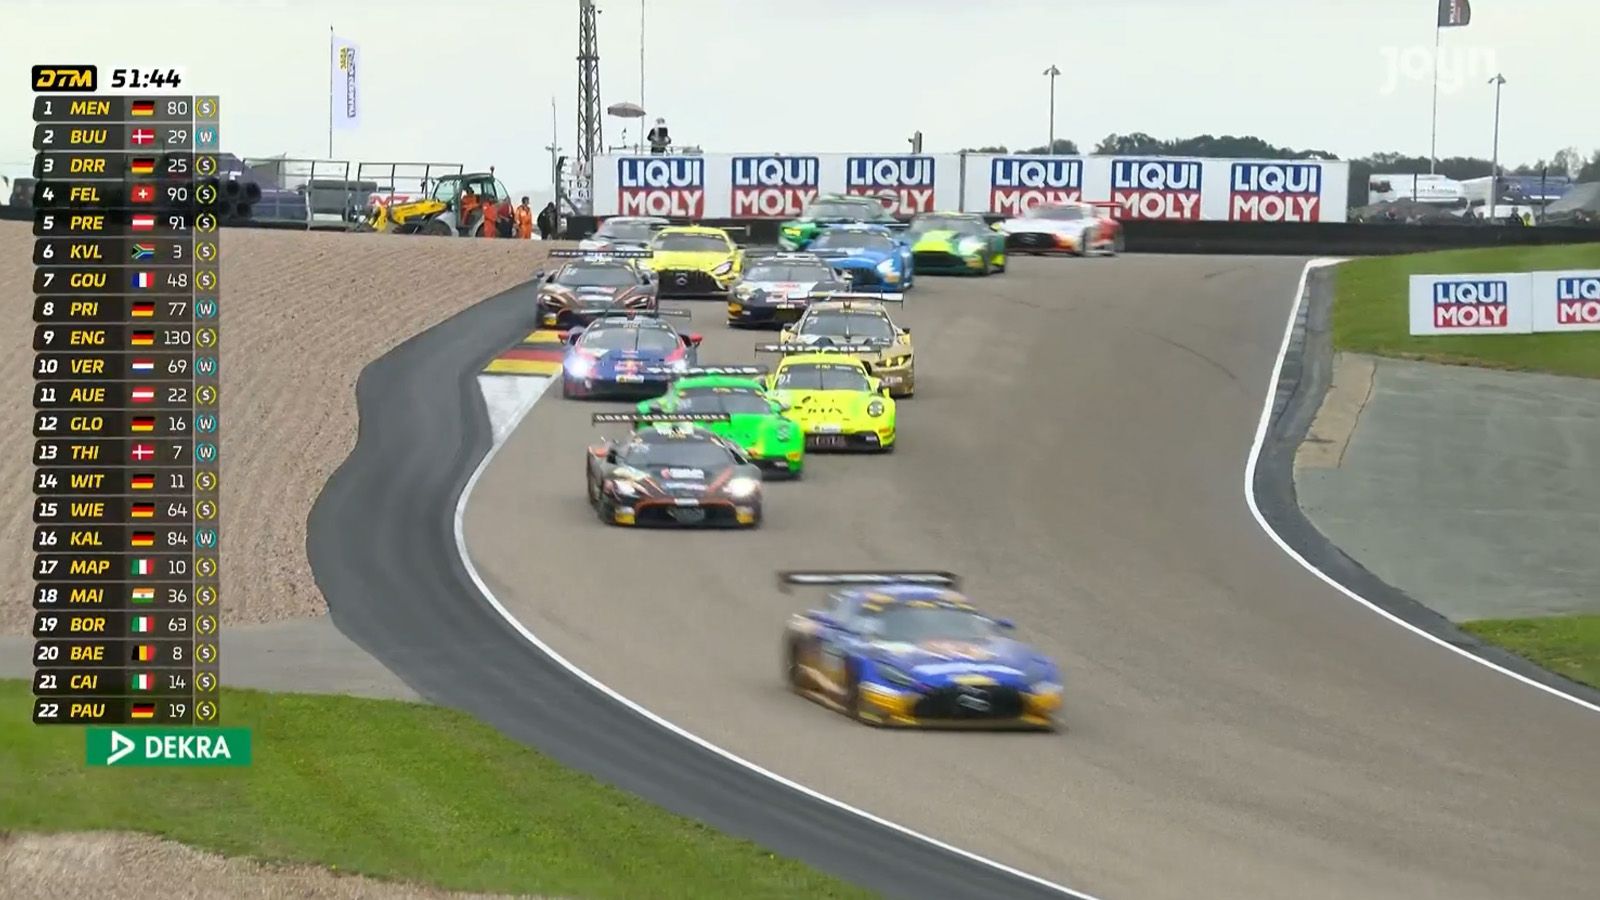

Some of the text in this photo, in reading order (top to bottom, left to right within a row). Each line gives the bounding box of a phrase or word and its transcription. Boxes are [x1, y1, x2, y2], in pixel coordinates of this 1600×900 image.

[622, 160, 700, 188] LIQUI
[736, 159, 815, 186] LIQUI
[851, 159, 931, 186] LIQUI
[996, 161, 1079, 188] LIQUI
[1115, 162, 1198, 190] LIQUI
[1235, 165, 1318, 193] LIQUI
[623, 190, 702, 216] MOLY
[735, 189, 817, 215] MOLY
[1114, 192, 1199, 218] MOLY
[1233, 195, 1318, 222] MOLY
[1437, 283, 1505, 304] LIQUI
[1437, 305, 1506, 326] MOLY
